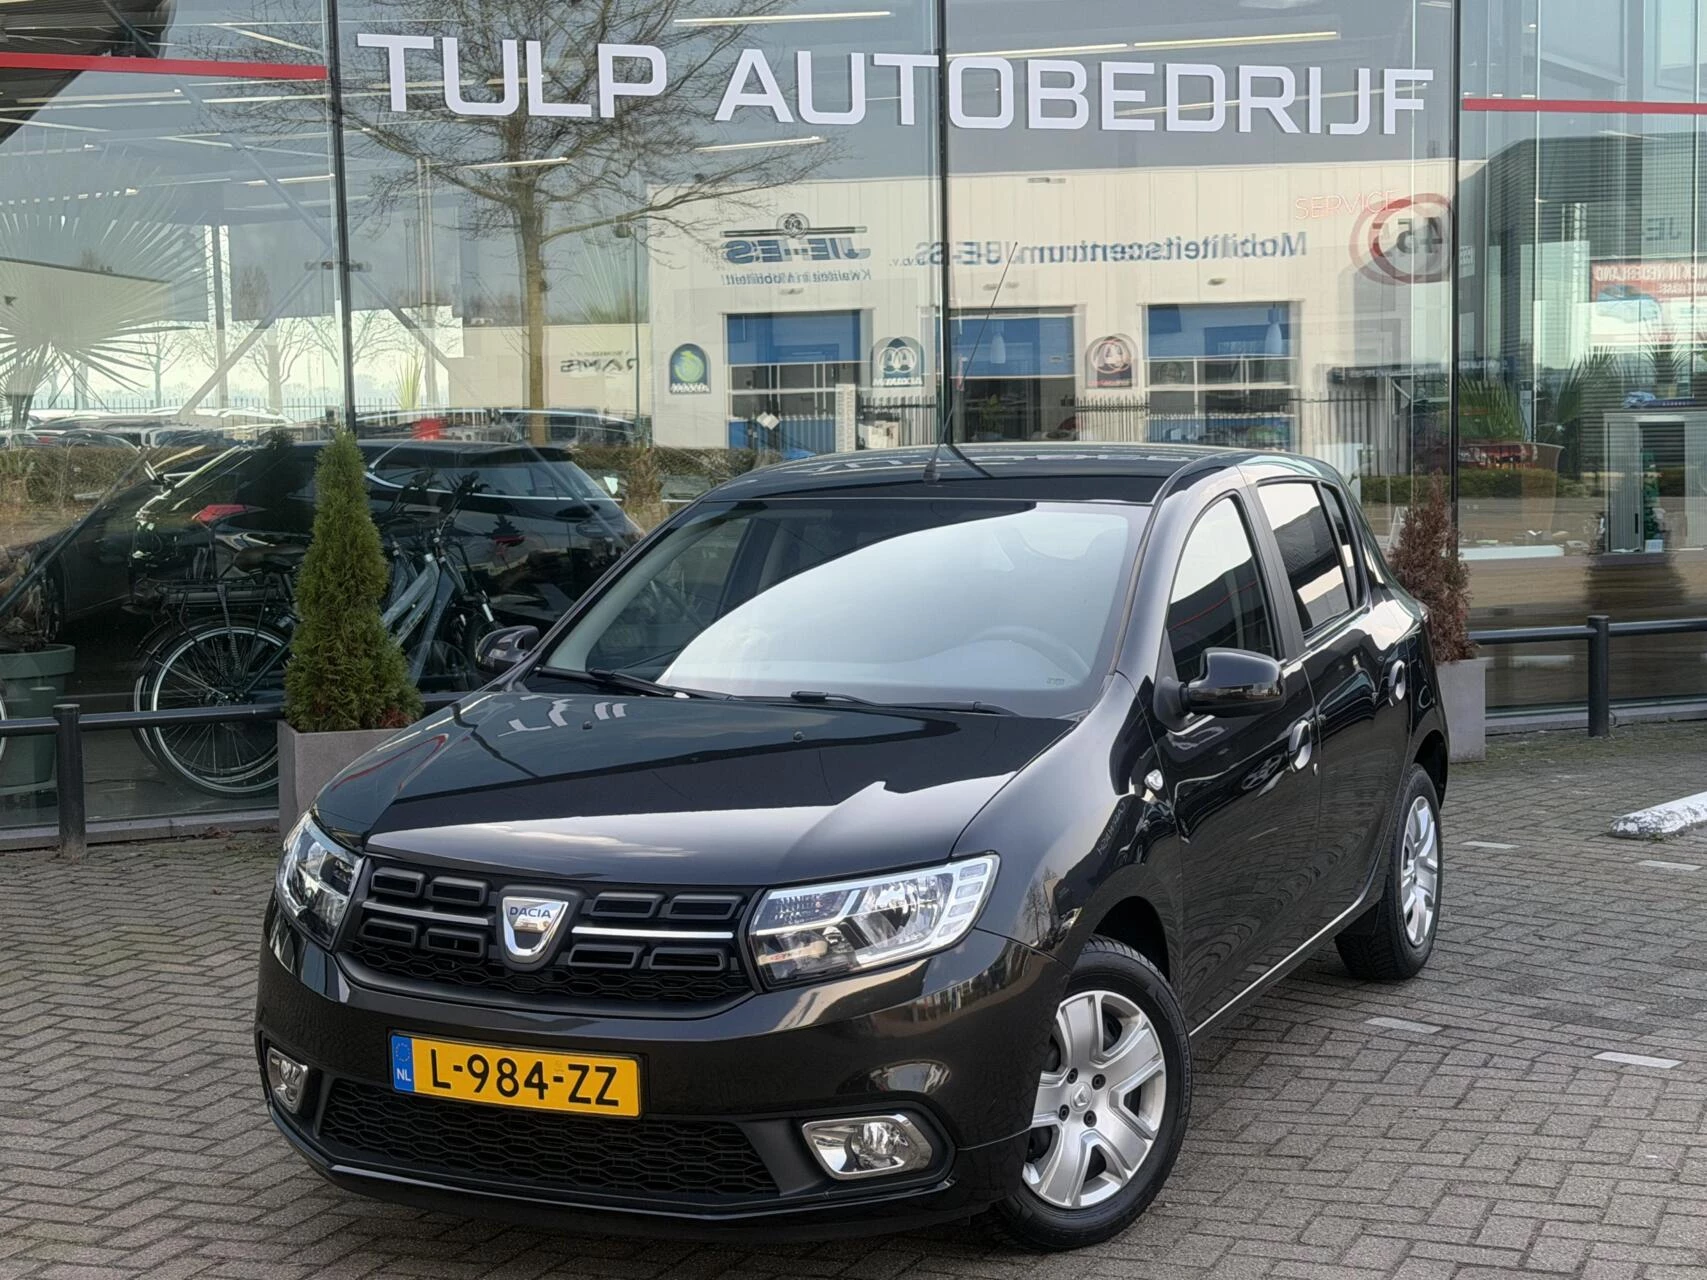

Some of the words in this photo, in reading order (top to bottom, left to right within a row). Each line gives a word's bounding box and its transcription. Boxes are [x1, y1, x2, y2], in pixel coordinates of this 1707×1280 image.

[357, 33, 667, 119] TULP
[714, 47, 1434, 136] AUTOBEDRIJF
[1295, 190, 1402, 221] SERVICE
[509, 905, 552, 919] DACIA
[396, 1067, 412, 1083] NL
[430, 1047, 620, 1107] L-984-ZZ
